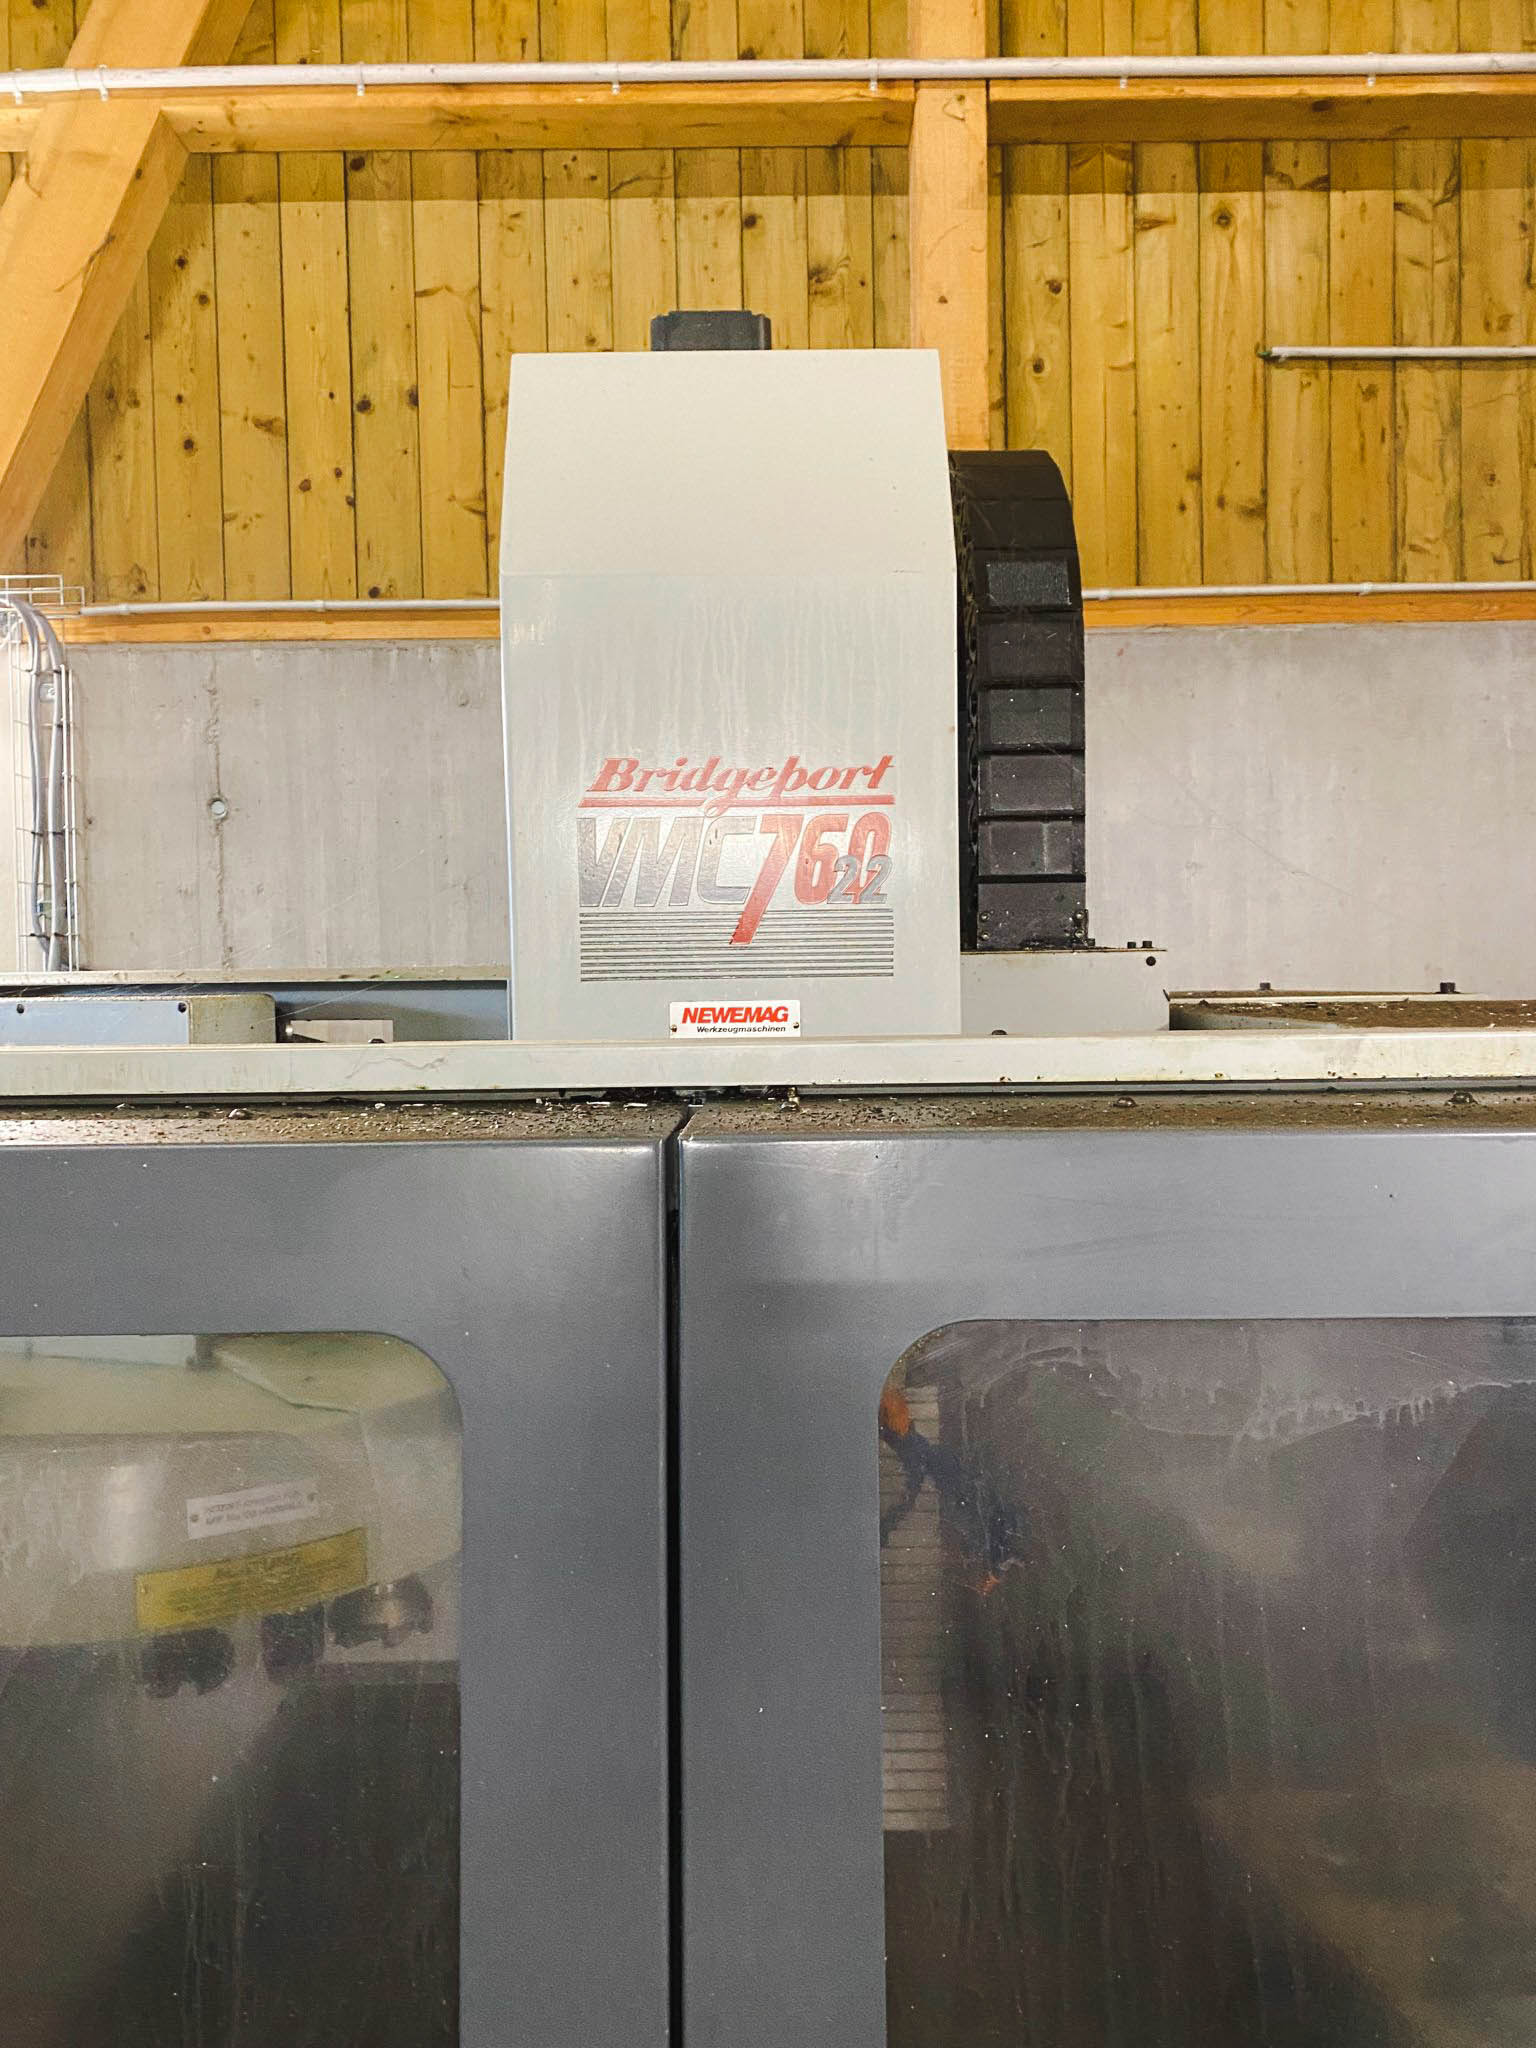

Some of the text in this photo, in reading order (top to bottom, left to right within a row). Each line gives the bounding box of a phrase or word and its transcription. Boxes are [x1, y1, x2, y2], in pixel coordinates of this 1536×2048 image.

[585, 755, 895, 817] Bridgeport
[682, 1006, 789, 1024] NEWEMAG
[697, 1025, 786, 1034] Werkzeugmaschinen
